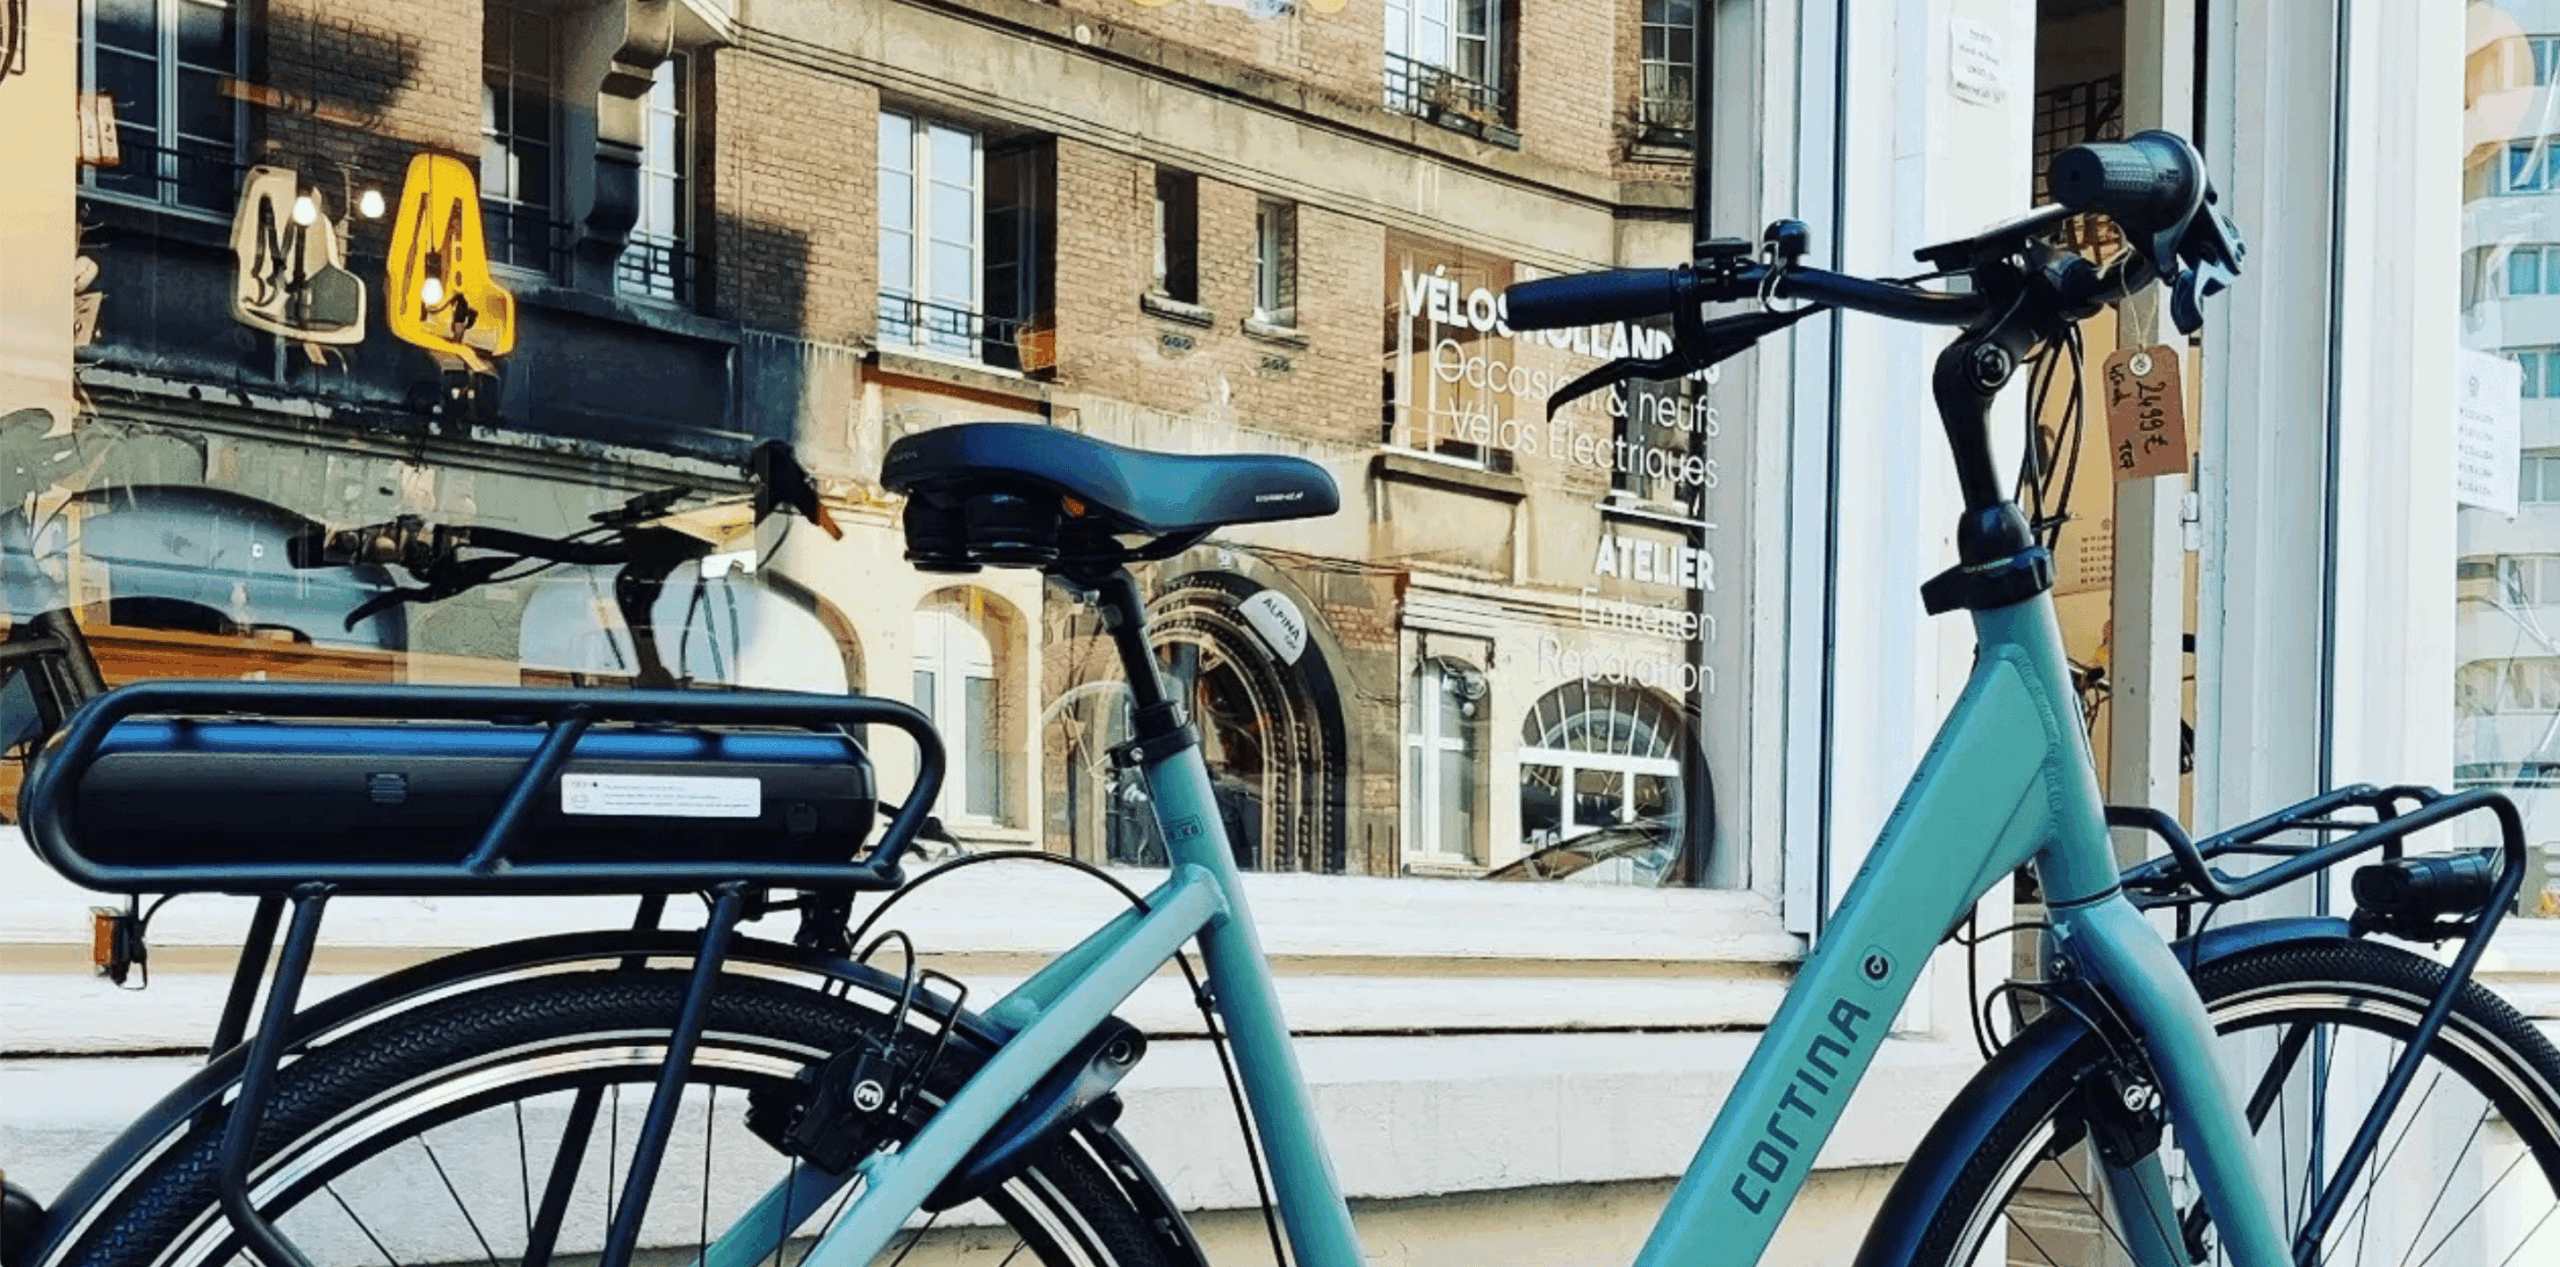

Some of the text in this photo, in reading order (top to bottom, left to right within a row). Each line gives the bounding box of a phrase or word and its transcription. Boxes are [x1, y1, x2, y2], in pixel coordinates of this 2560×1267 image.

[1449, 396, 1538, 454] Vélos
[1606, 378, 1629, 418] &
[1639, 391, 1720, 438] neufs
[2135, 381, 2169, 455] 2499€
[1594, 533, 1716, 592] ATELIER
[1262, 597, 1300, 640] ALPINA
[1581, 587, 1717, 643] Entretien
[1538, 632, 1717, 694] Réparation
[1731, 997, 1871, 1215] CORTINA
